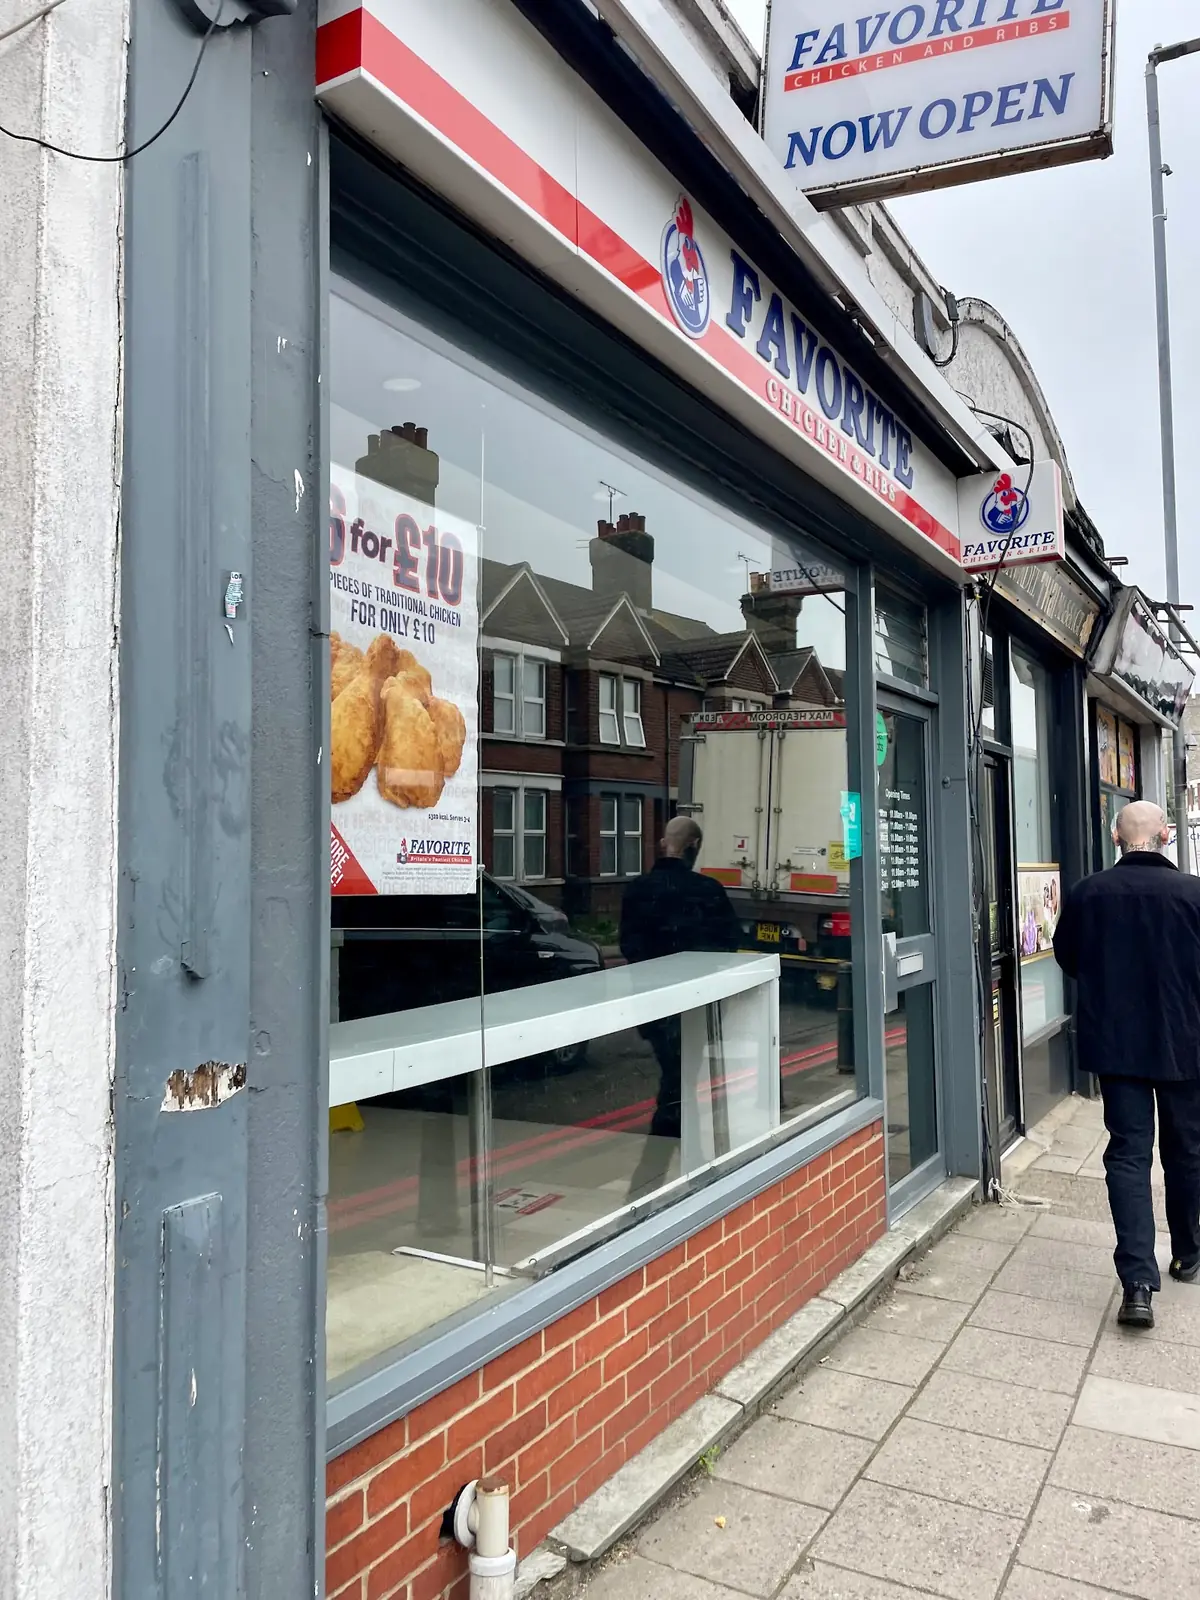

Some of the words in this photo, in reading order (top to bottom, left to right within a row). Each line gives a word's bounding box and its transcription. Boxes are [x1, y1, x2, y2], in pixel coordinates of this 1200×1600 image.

[786, 0, 1063, 72] FAVORI
[794, 51, 903, 88] CHICKEN
[924, 35, 974, 56] AND
[996, 17, 1058, 42] RIBS
[784, 105, 913, 169] NOW
[919, 72, 1075, 140] OPEN
[725, 249, 914, 490] FAVORITE
[766, 378, 848, 464] CHICKEN
[850, 450, 862, 475] &
[863, 462, 897, 503] RIBS
[350, 517, 392, 563] for
[392, 513, 464, 606] £10
[963, 531, 1055, 557] FAVORITE
[1029, 545, 1056, 553] RIBS
[351, 599, 376, 628] FOR
[380, 607, 410, 637] ONLY
[413, 618, 436, 645] £10
[361, 582, 372, 599] OF
[375, 586, 428, 617] TRADITIONAL
[430, 604, 461, 627] CHICKEN
[331, 831, 350, 869] ORE
[410, 840, 471, 855] FAVORITE
